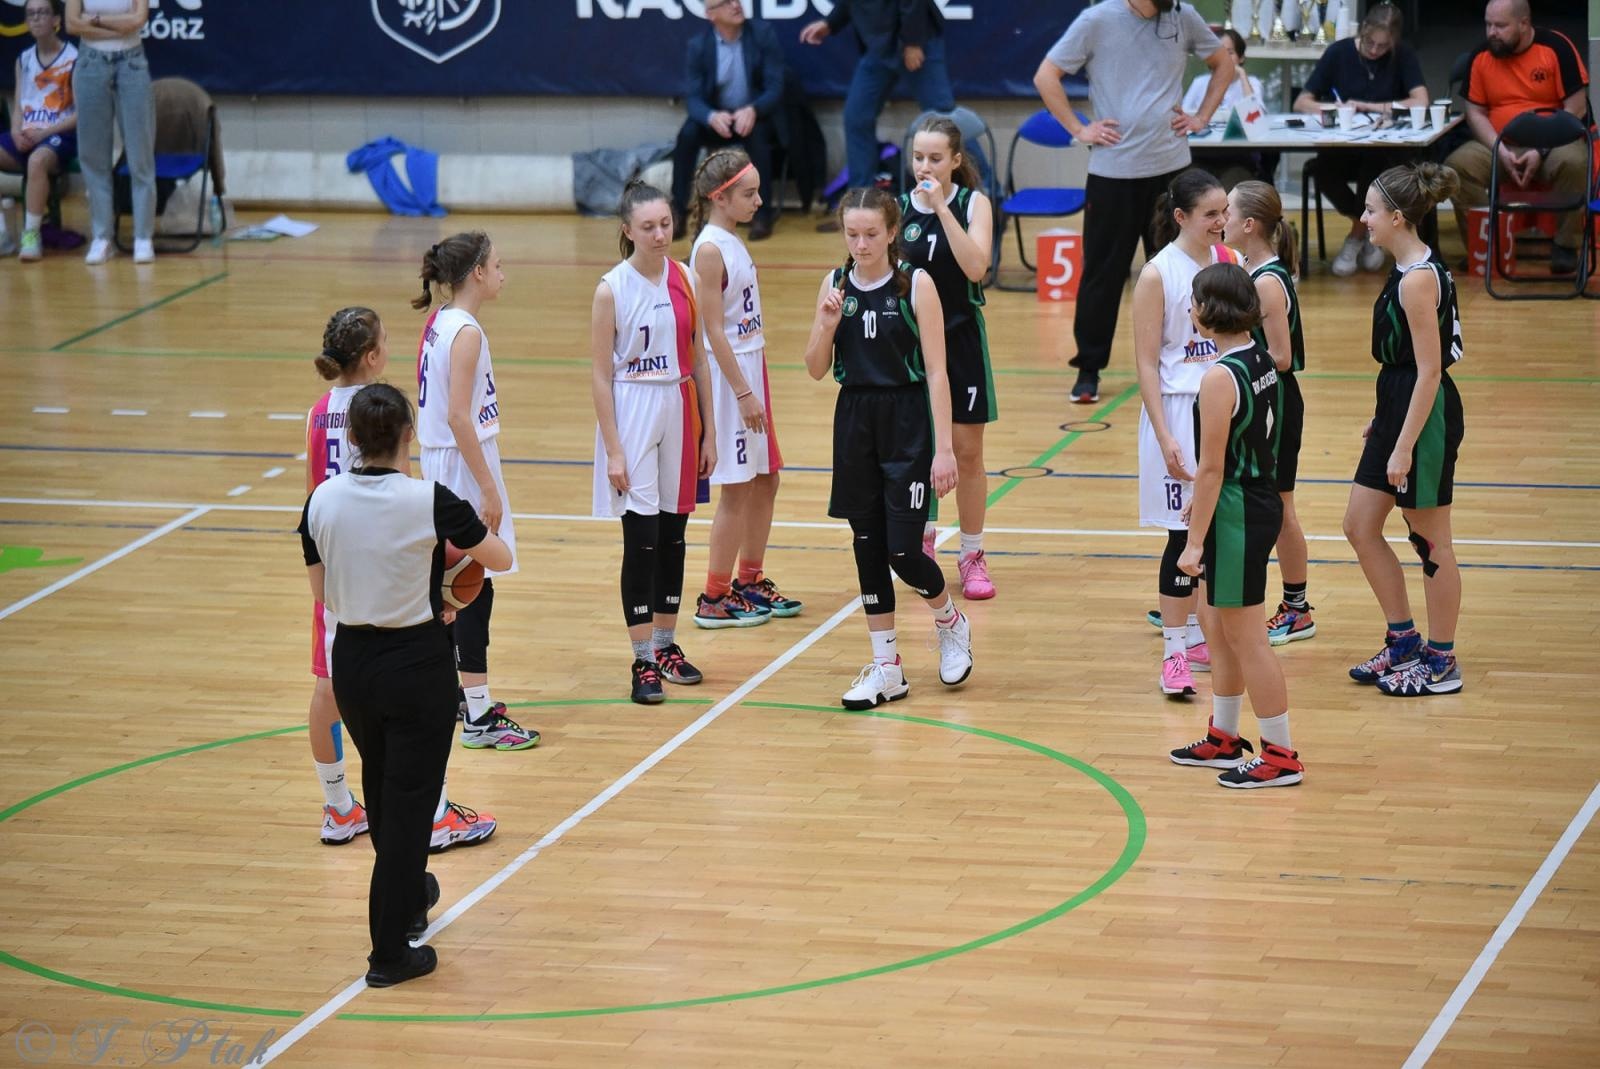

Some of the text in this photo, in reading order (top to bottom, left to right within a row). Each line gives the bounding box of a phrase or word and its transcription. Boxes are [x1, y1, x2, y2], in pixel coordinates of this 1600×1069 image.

[927, 234, 937, 261] 7
[1045, 240, 1075, 286] 5
[738, 314, 761, 335] MIN
[862, 310, 877, 339] 10
[1184, 339, 1218, 358] MIN
[627, 355, 668, 373] MINI
[967, 386, 977, 411] 7
[314, 409, 348, 429] RACIBÓ
[909, 481, 925, 509] 10
[1165, 482, 1183, 511] 13
[865, 594, 879, 605] NBA
